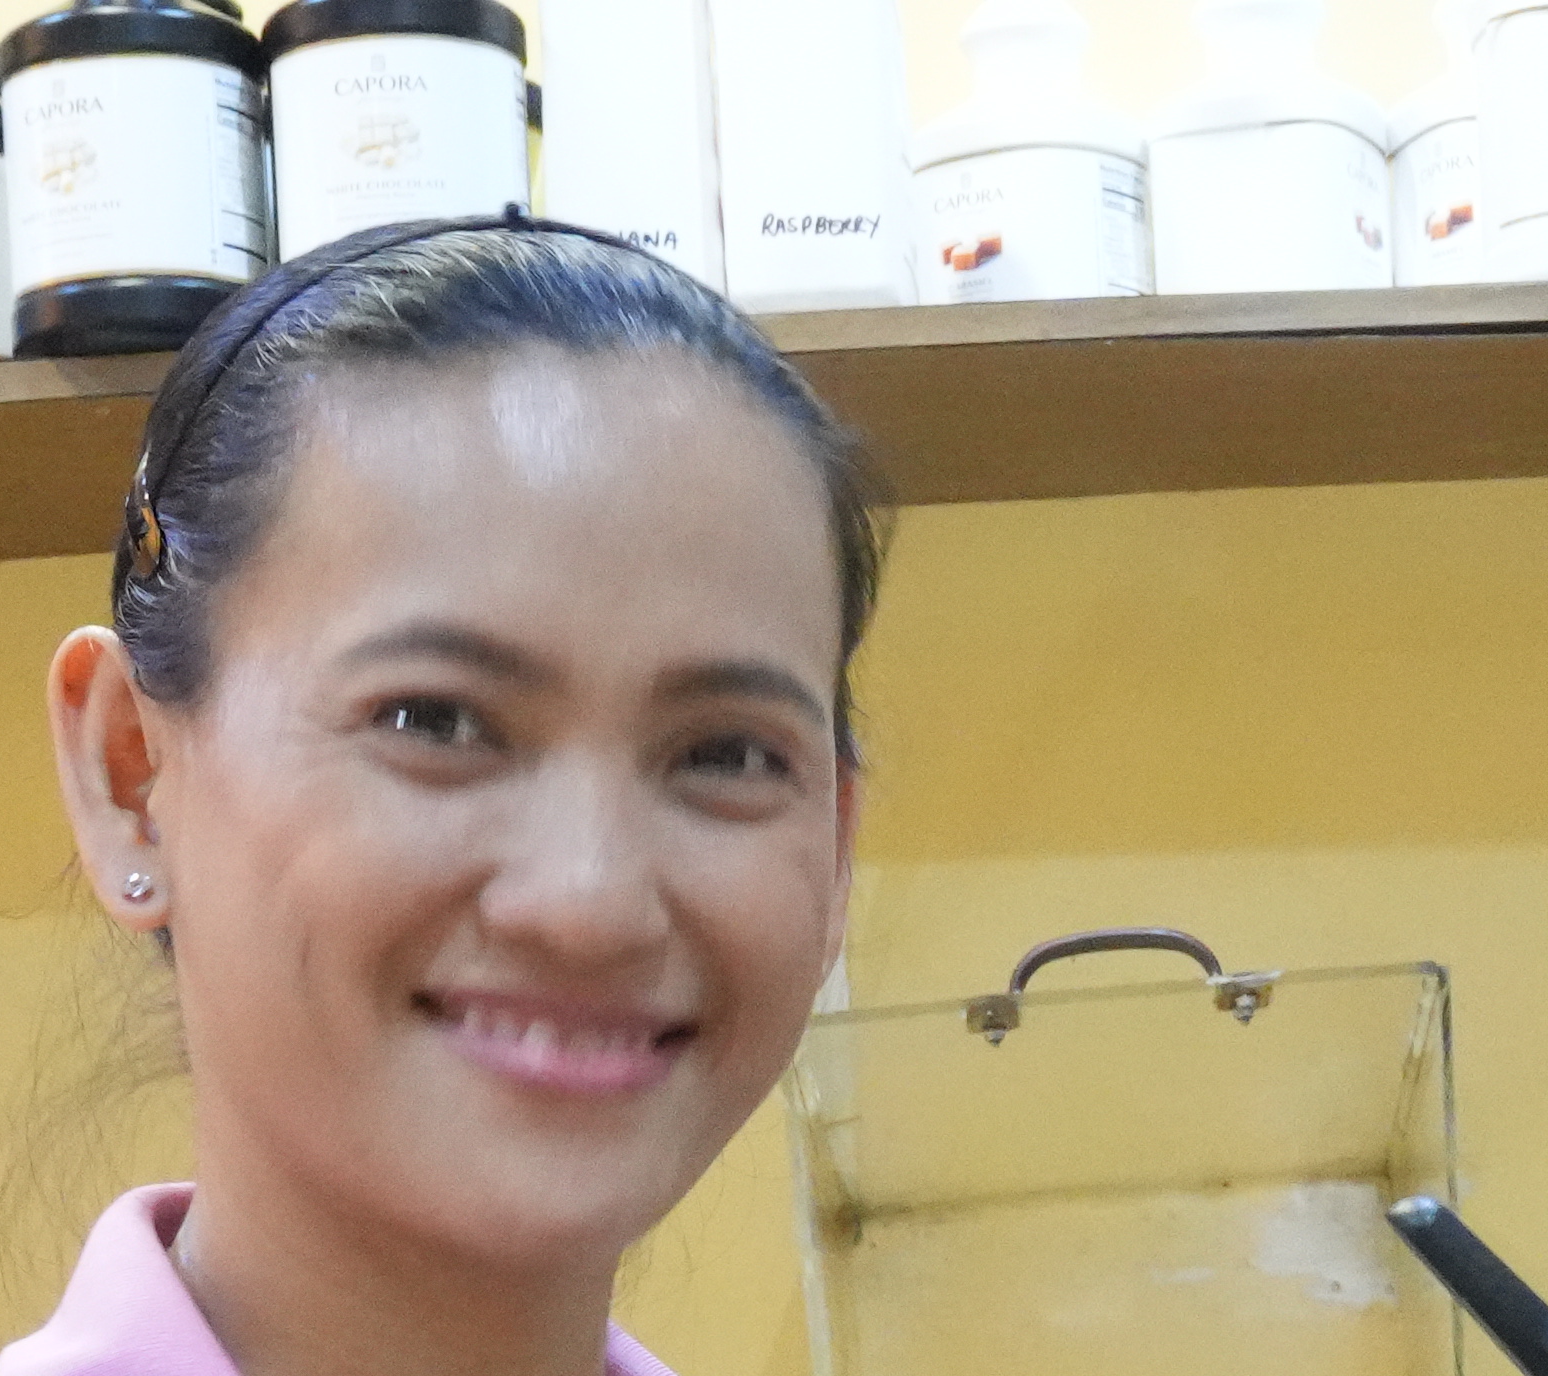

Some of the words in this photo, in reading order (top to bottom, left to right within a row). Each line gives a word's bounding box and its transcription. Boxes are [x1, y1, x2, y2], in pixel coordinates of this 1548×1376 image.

[333, 73, 429, 97] CAPORA
[23, 96, 105, 126] CAPORA
[933, 186, 1005, 214] CAPORA
[761, 212, 882, 239] RASPBERRY
